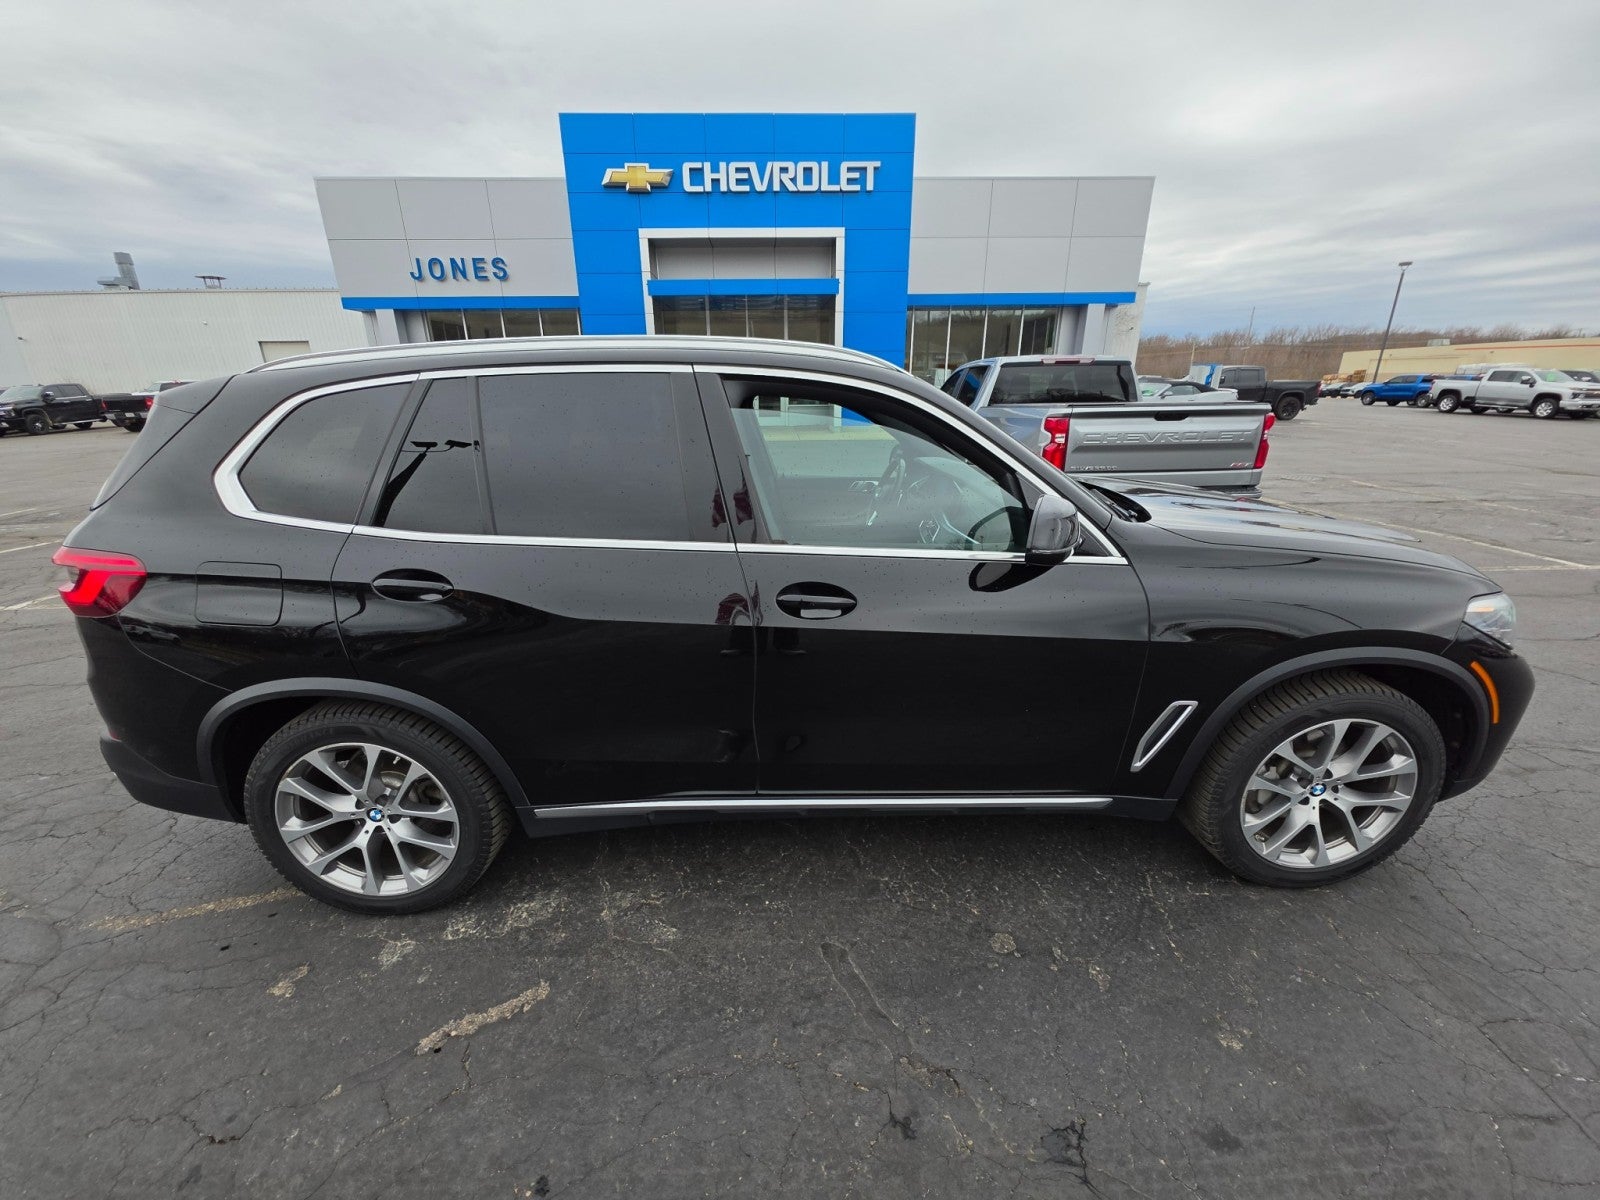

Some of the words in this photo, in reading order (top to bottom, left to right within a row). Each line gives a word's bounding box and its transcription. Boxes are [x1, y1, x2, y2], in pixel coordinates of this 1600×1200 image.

[682, 160, 881, 192] CHEVROLET
[409, 257, 509, 281] JONES
[1083, 431, 1252, 444] CHEVROLET
